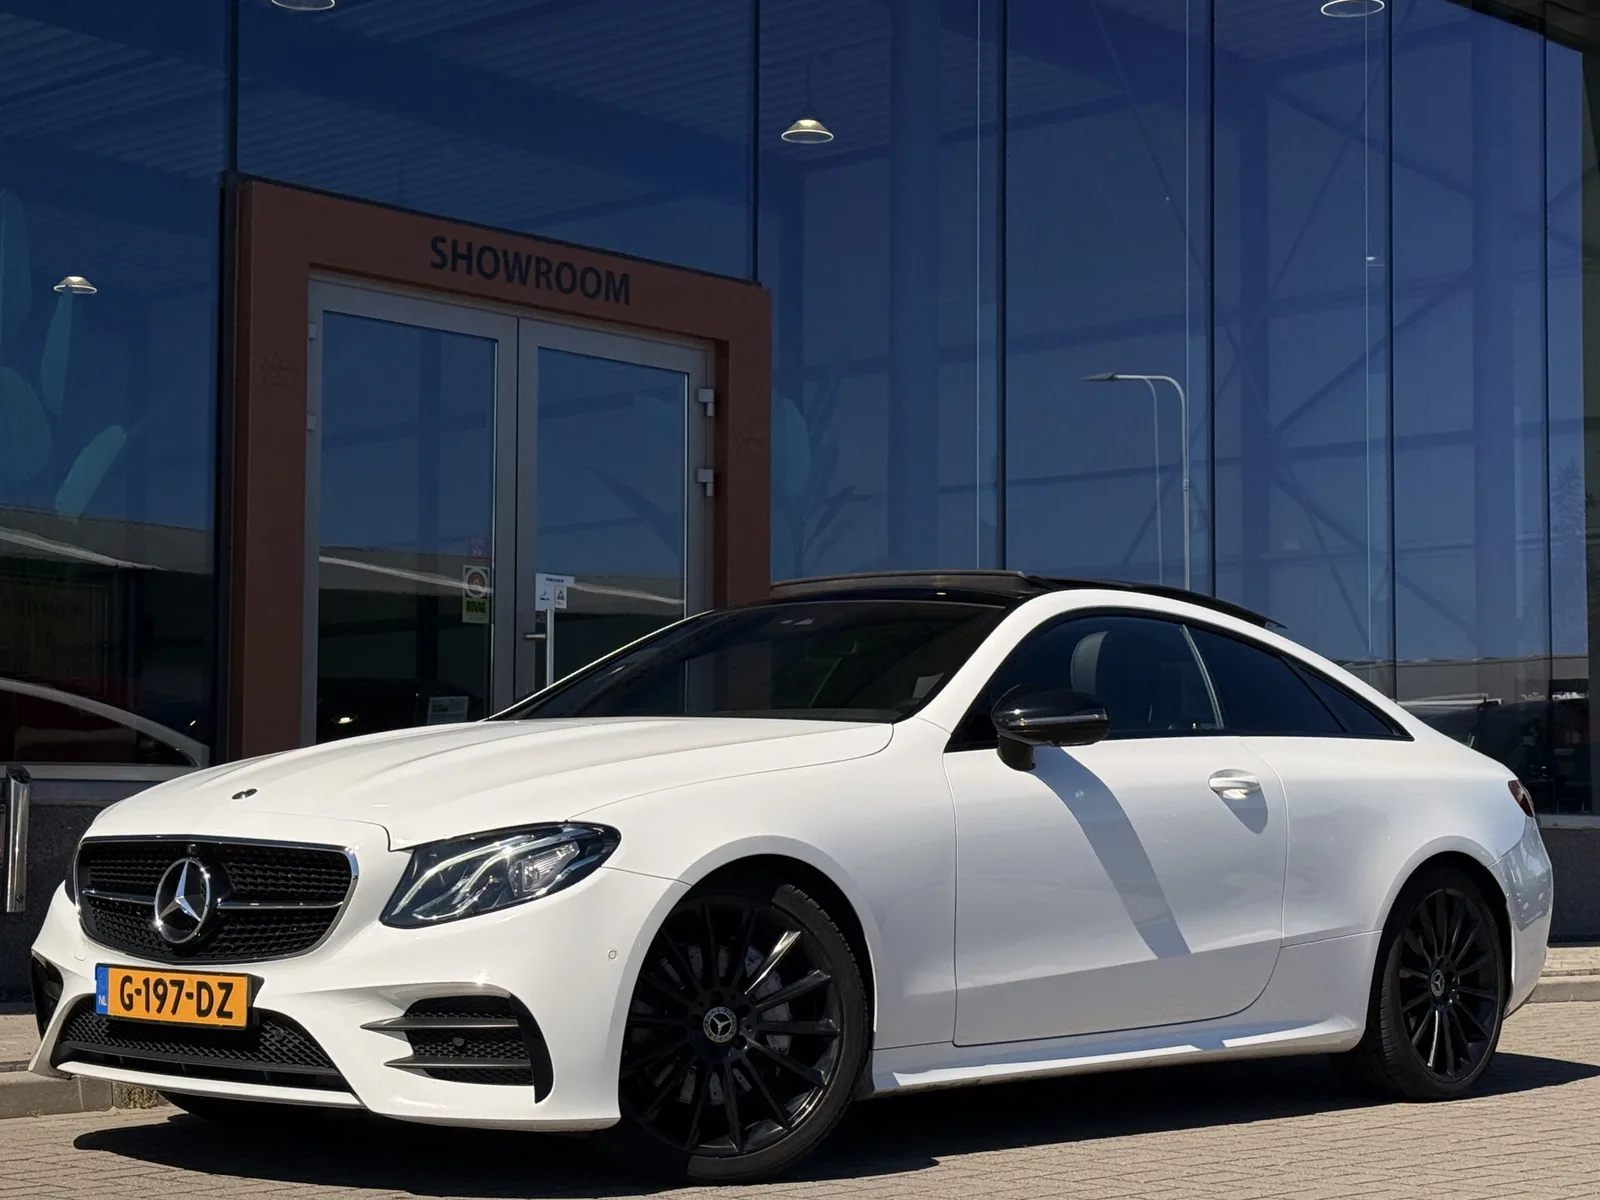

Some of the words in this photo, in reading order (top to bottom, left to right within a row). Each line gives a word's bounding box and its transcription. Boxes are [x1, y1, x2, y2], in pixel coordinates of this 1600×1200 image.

[430, 236, 631, 305] SHOWROOM
[466, 599, 486, 613] BOVAG
[98, 994, 107, 1006] NL
[119, 975, 234, 1019] G-197-DZ
